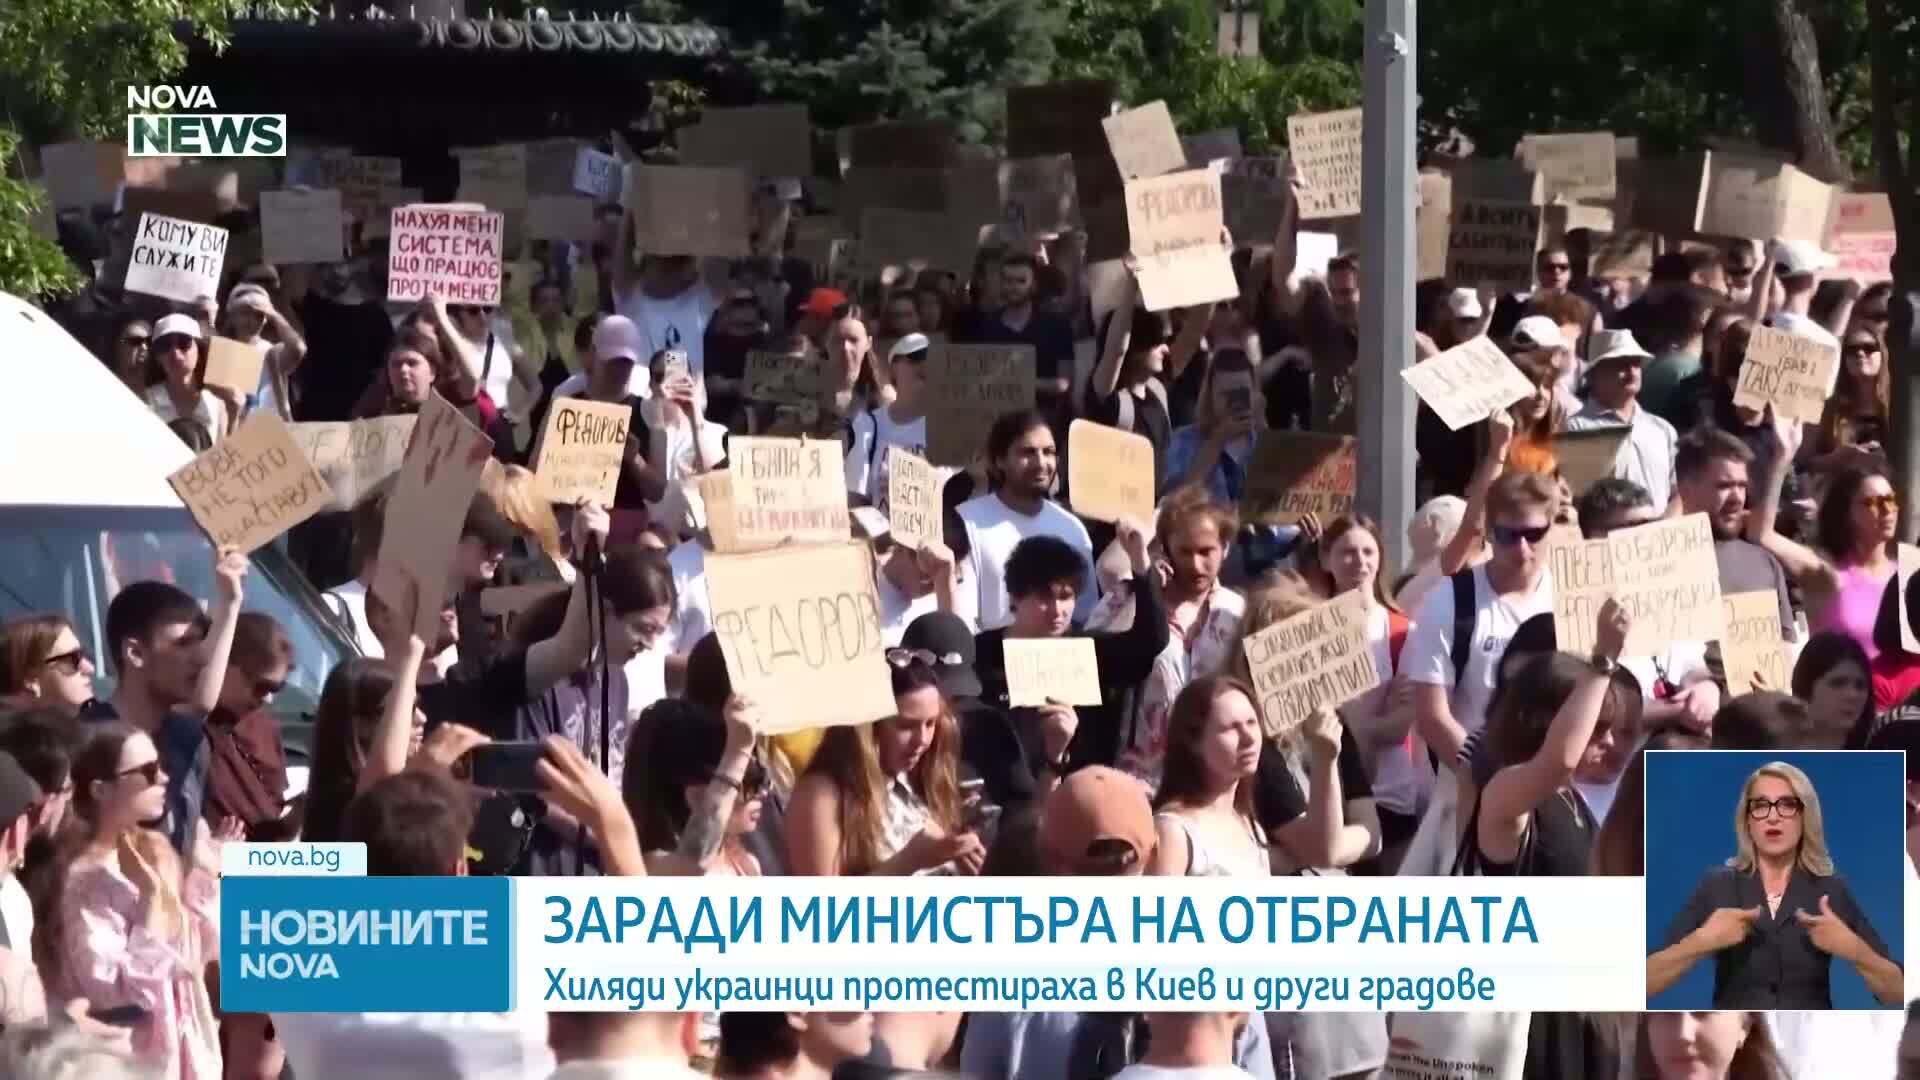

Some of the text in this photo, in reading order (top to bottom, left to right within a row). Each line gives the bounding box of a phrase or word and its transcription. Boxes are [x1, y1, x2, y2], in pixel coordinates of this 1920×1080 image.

[144, 217, 226, 254] КОМУ ВИ
[394, 211, 498, 234] НАХУЯ МЕНІ
[391, 256, 499, 280] ЩО ПРАЦЮЄ
[390, 279, 498, 302] ПРОТИ МЕНЕ?
[556, 408, 625, 445] ФЕДОРОВ
[716, 592, 881, 680] ФЕДОРОВ
